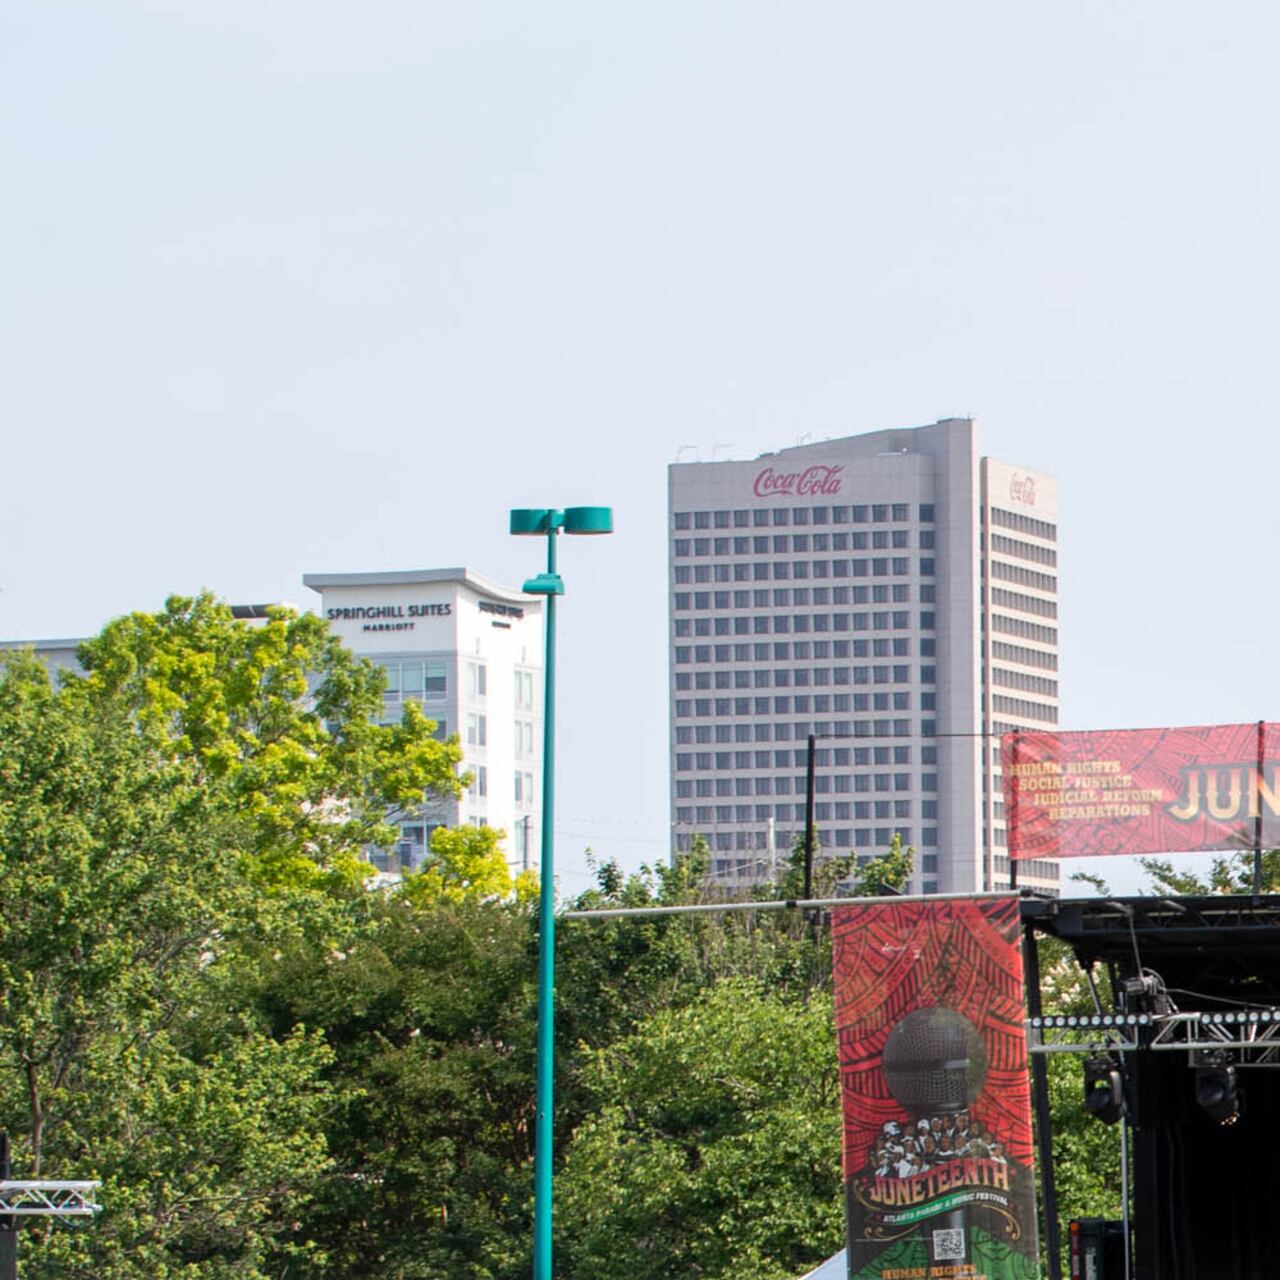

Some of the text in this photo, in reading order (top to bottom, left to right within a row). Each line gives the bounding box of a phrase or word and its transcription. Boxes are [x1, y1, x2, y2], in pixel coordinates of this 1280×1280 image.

[753, 465, 846, 497] Coca-Cola
[327, 604, 451, 620] SPRINGHILL SUITES
[363, 623, 415, 632] MARRIOTT
[1010, 761, 1121, 775] HUMAN RIGHTS
[1018, 775, 1132, 791] SOCIAL JUSTICE
[1034, 789, 1163, 805] JUDICIAL REFORM
[1049, 804, 1150, 820] REPARATIONS
[870, 1158, 1009, 1205] JUNETEENTH
